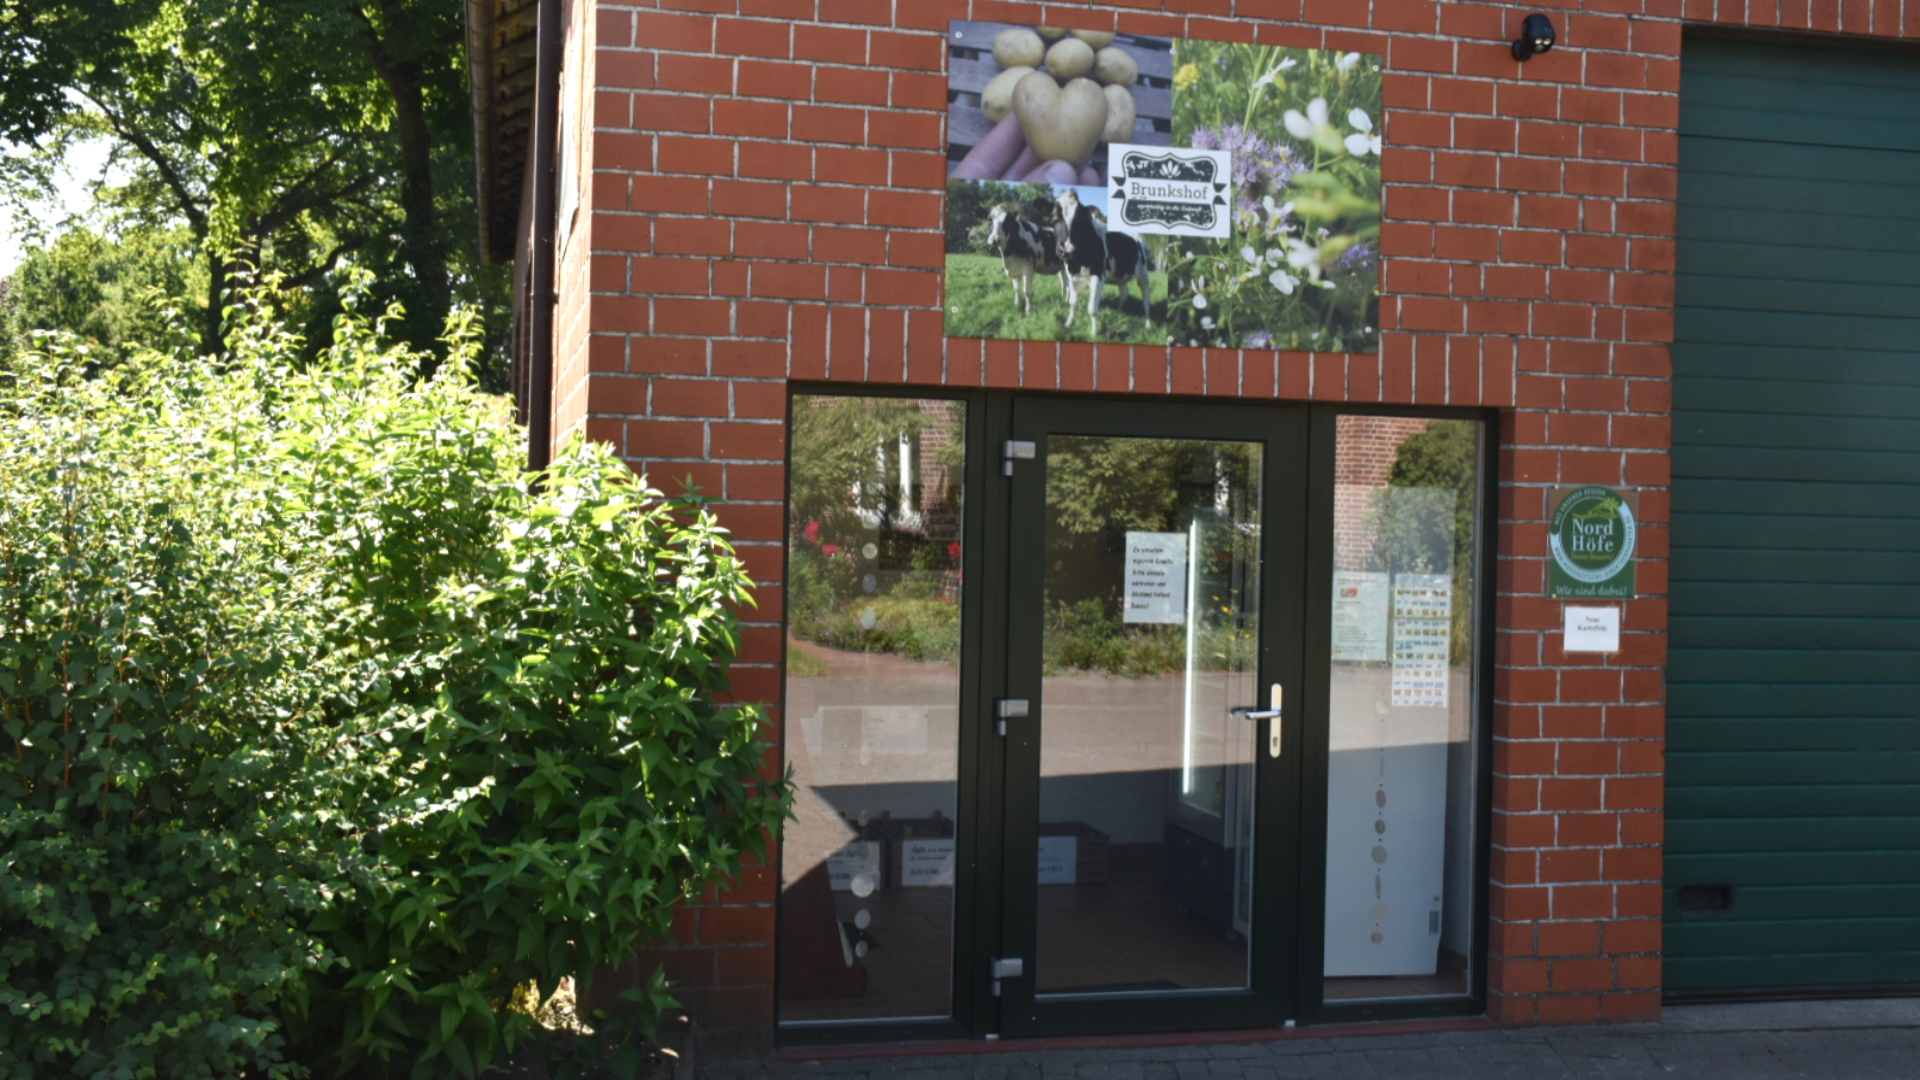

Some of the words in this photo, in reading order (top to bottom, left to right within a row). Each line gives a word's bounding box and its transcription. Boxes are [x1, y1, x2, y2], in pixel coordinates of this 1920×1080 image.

[1131, 182, 1208, 199] Brunkshof
[1554, 511, 1563, 525] AUS
[1584, 487, 1607, 496] REGION
[1572, 518, 1614, 535] Nord
[1572, 534, 1614, 552] Höfe
[1556, 586, 1572, 595] Wir
[1575, 585, 1597, 596] sind
[1598, 585, 1627, 596] dabei!
